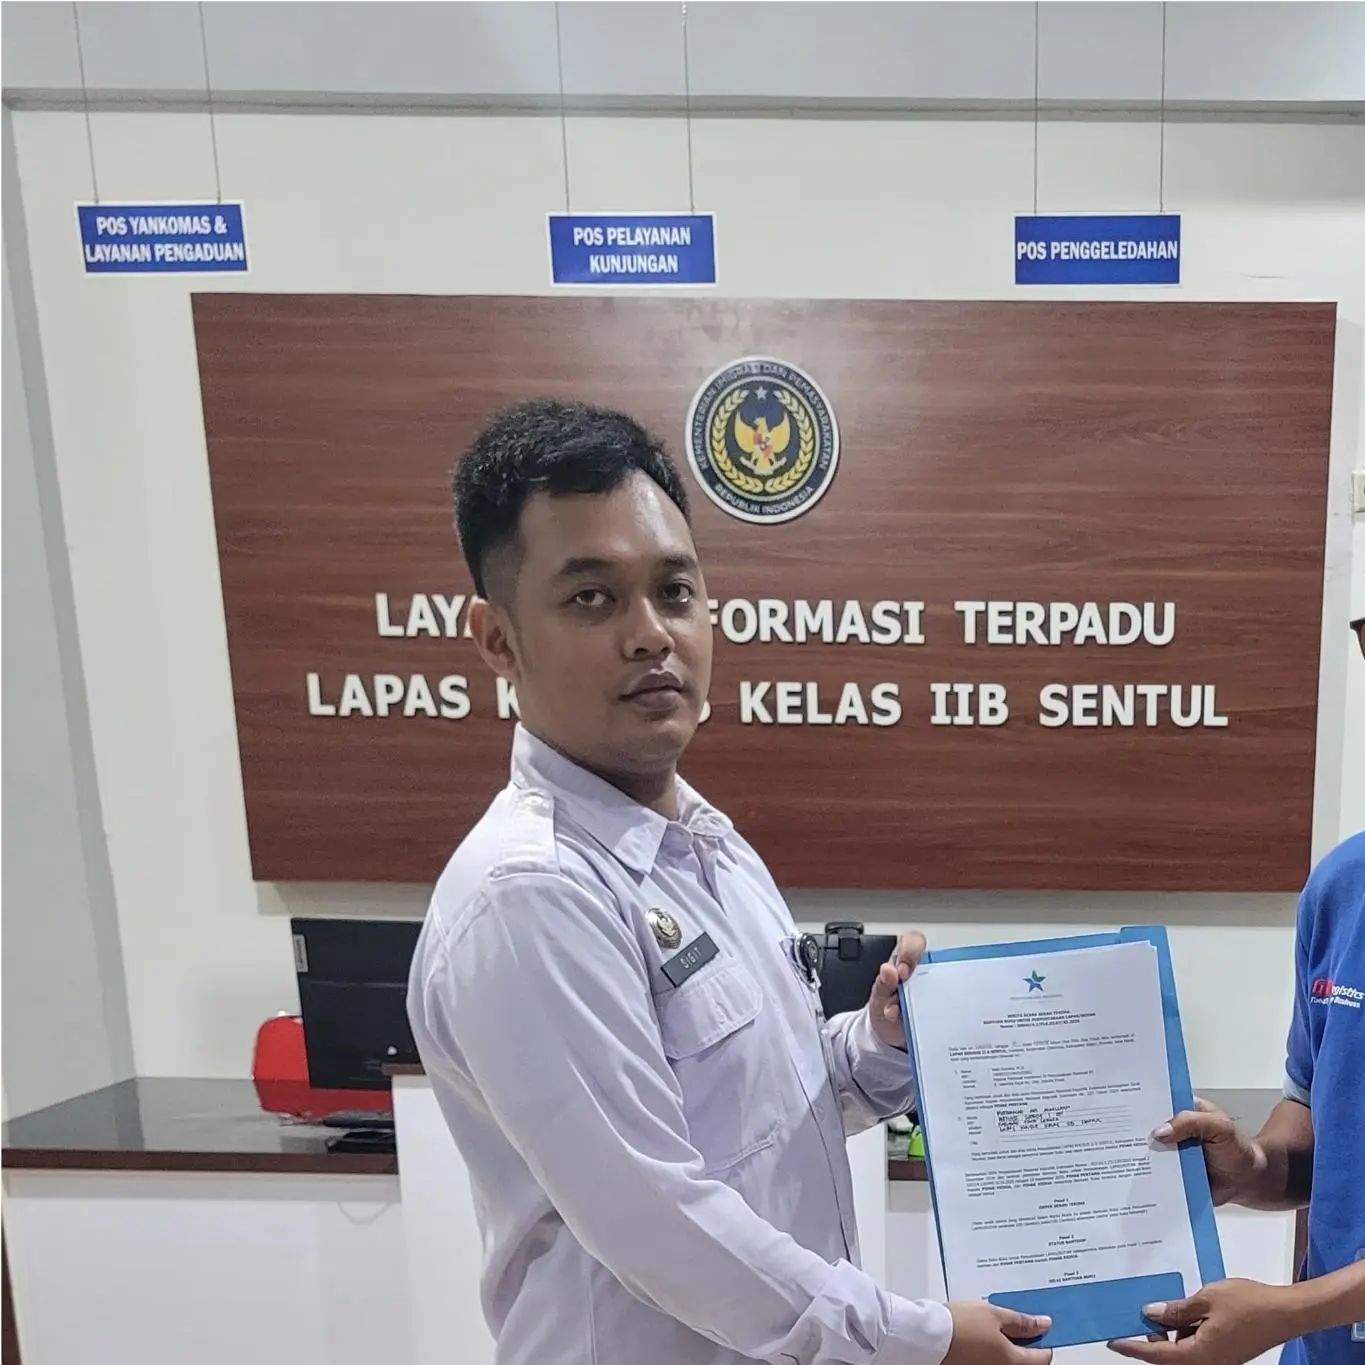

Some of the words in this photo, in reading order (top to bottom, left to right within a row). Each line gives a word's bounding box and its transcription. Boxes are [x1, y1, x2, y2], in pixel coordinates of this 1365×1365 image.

[96, 216, 127, 235] POS
[129, 215, 211, 235] YANKOMAS
[214, 215, 227, 234] &
[573, 227, 603, 246] POS
[607, 227, 691, 246] PELAYANAN
[85, 243, 151, 262] LAYANAN
[154, 242, 244, 262] PENGADUAN
[1017, 241, 1047, 260] POS
[1050, 240, 1178, 260] PENGGELEDAHAN
[589, 254, 678, 274] KUNJUNGAN
[714, 483, 760, 514] REPUBLIK
[762, 486, 813, 514] INDONESIA
[955, 601, 1176, 646] TERPADU
[306, 673, 471, 719] LAPAS
[739, 681, 902, 726] KELAS
[930, 683, 1009, 726] IIB
[1039, 684, 1229, 727] SENTUL
